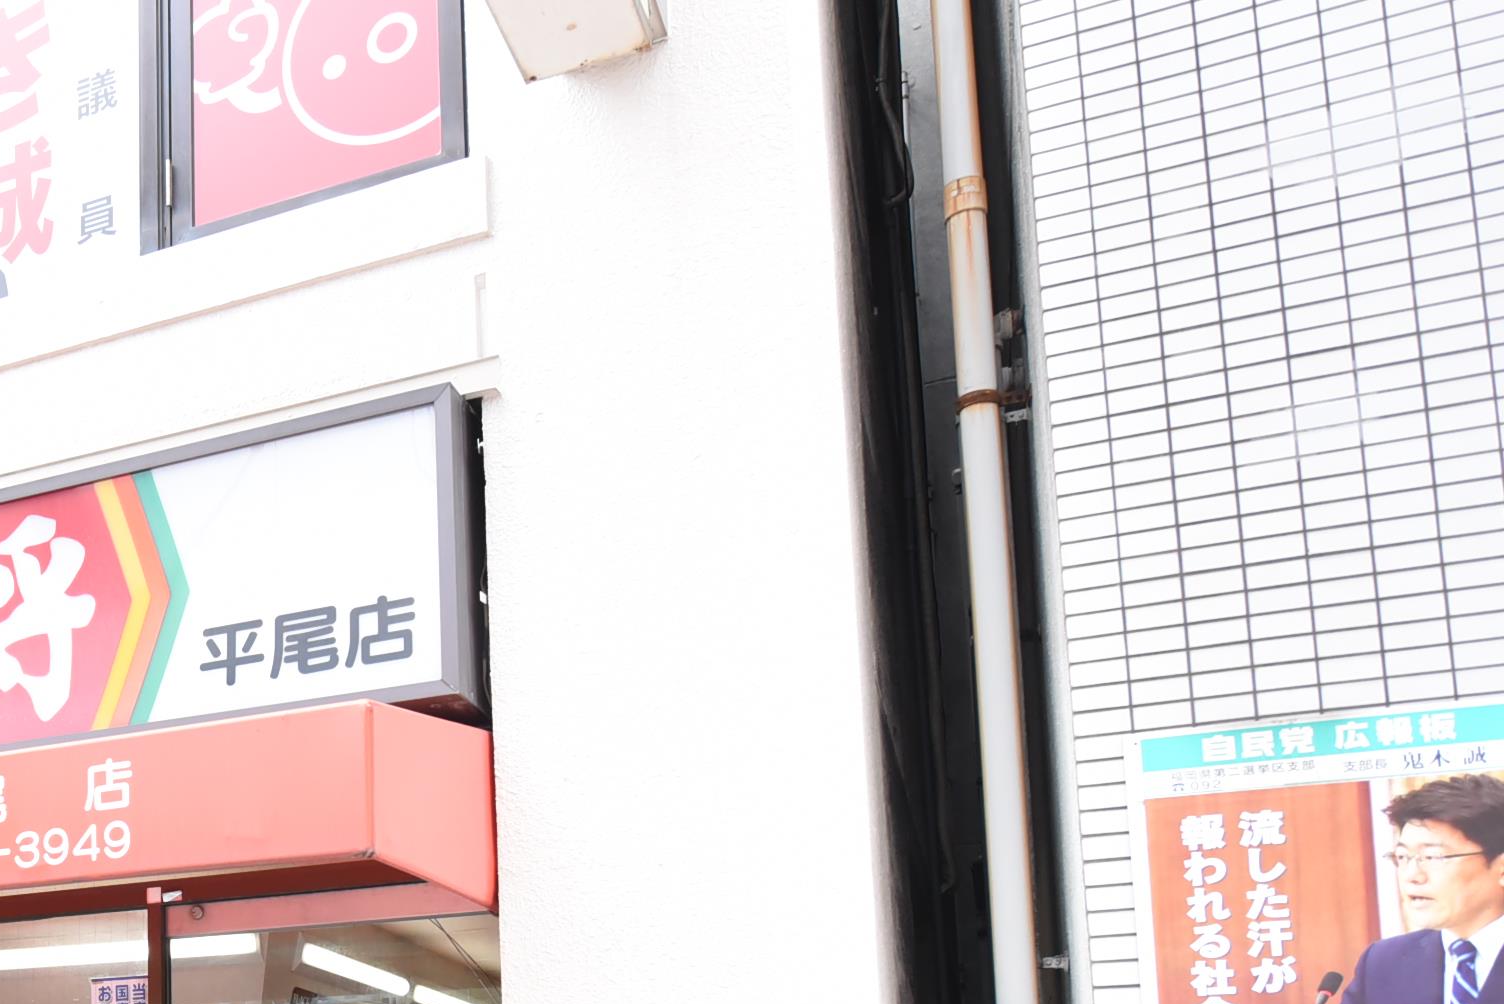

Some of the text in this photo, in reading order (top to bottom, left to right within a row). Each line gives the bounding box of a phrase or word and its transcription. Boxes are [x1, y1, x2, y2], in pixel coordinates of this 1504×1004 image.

[199, 595, 416, 686] 平尾店
[1201, 713, 1457, 762] 自民党 広報板
[1238, 809, 1297, 994] 流した汗が
